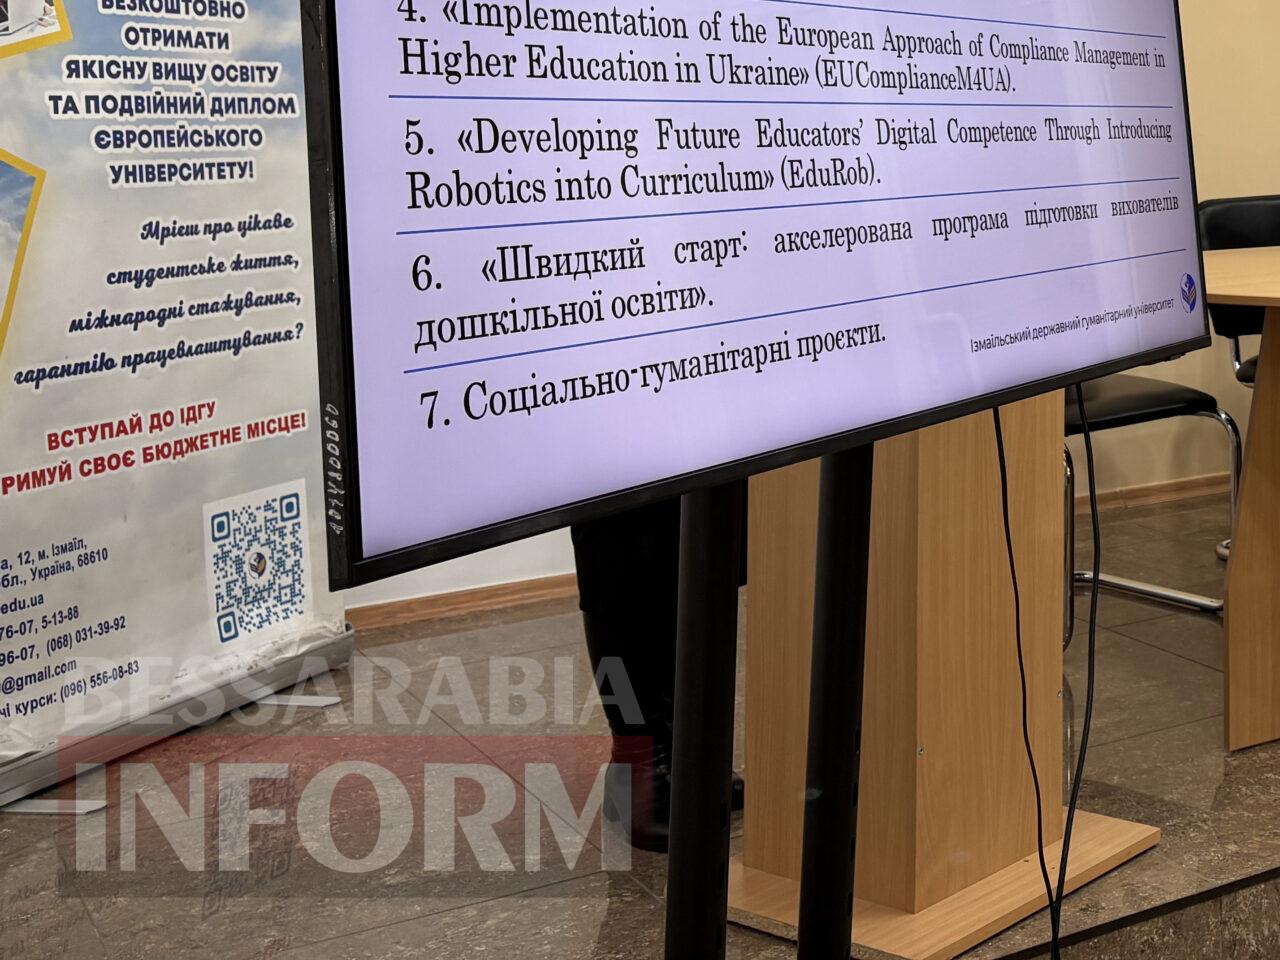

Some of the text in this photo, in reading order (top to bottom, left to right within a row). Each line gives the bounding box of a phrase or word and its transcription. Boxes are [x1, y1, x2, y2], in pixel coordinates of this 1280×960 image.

[124, 26, 229, 50] ОТРИМАТИ
[699, 10, 722, 42] of
[731, 13, 767, 45] the
[776, 16, 875, 54] European
[881, 25, 964, 62] Approach
[969, 33, 984, 57] of
[989, 34, 1070, 64] Compliance
[1074, 41, 1151, 70] Management
[1154, 48, 1166, 69] in
[66, 59, 278, 85] ЯКІСНУ ВИЩУ ОСВІТУ
[399, 37, 1016, 96] Higher Education in Ukraine» (EUComplianceM4UA).
[48, 91, 296, 117] ТА ПОДВІЙНИЙ ДИПЛОМ
[94, 125, 263, 150] ЄВРОПЕЙСЬКОГО
[405, 119, 435, 156] 5.
[457, 117, 639, 159] «Developing
[655, 117, 741, 151] Future
[876, 117, 938, 150] Digital
[947, 119, 1038, 148] Competence
[1044, 117, 1101, 145] Through
[1106, 117, 1173, 143] Introducing
[109, 161, 254, 184] УНІВЕРСИТЕТУ!
[405, 153, 882, 210] Robotics into Curriculum» (EduRob).
[140, 213, 294, 245] Мрієш про цікаве
[411, 190, 1179, 291] 6. «Швидкий старт: акселерована програма підготовки вихователів
[106, 253, 299, 289] студентське життя,
[69, 291, 301, 333] міжнародні стажування,
[414, 281, 714, 354] дошкільної освіти».
[969, 298, 1175, 353] Ізмаїльський державний гуманітарний університет
[14, 322, 304, 389] гарантію працевлаштування?
[419, 323, 886, 430] 7. Соціально-гуманітарні проєкти.
[47, 401, 216, 451] ВСТУПАЙ ДО ІДГУ
[79, 450, 135, 478] СВОЄ
[142, 426, 242, 464] БЮДЖЕТНЕ
[247, 412, 306, 440] МІСЦЕ!
[17, 551, 35, 566] 12,
[38, 550, 49, 561] м.
[51, 537, 87, 557] Ізмаїл,
[30, 560, 75, 582] Україна,
[77, 547, 108, 568] 68610
[41, 605, 80, 629] 5-13-88
[46, 631, 73, 657] (068)
[75, 615, 126, 644] 031-39-92
[0, 658, 77, 694] @gmail.com
[15, 691, 57, 717] курси:
[60, 678, 87, 703] (096)
[90, 659, 140, 689] 556-08-83
